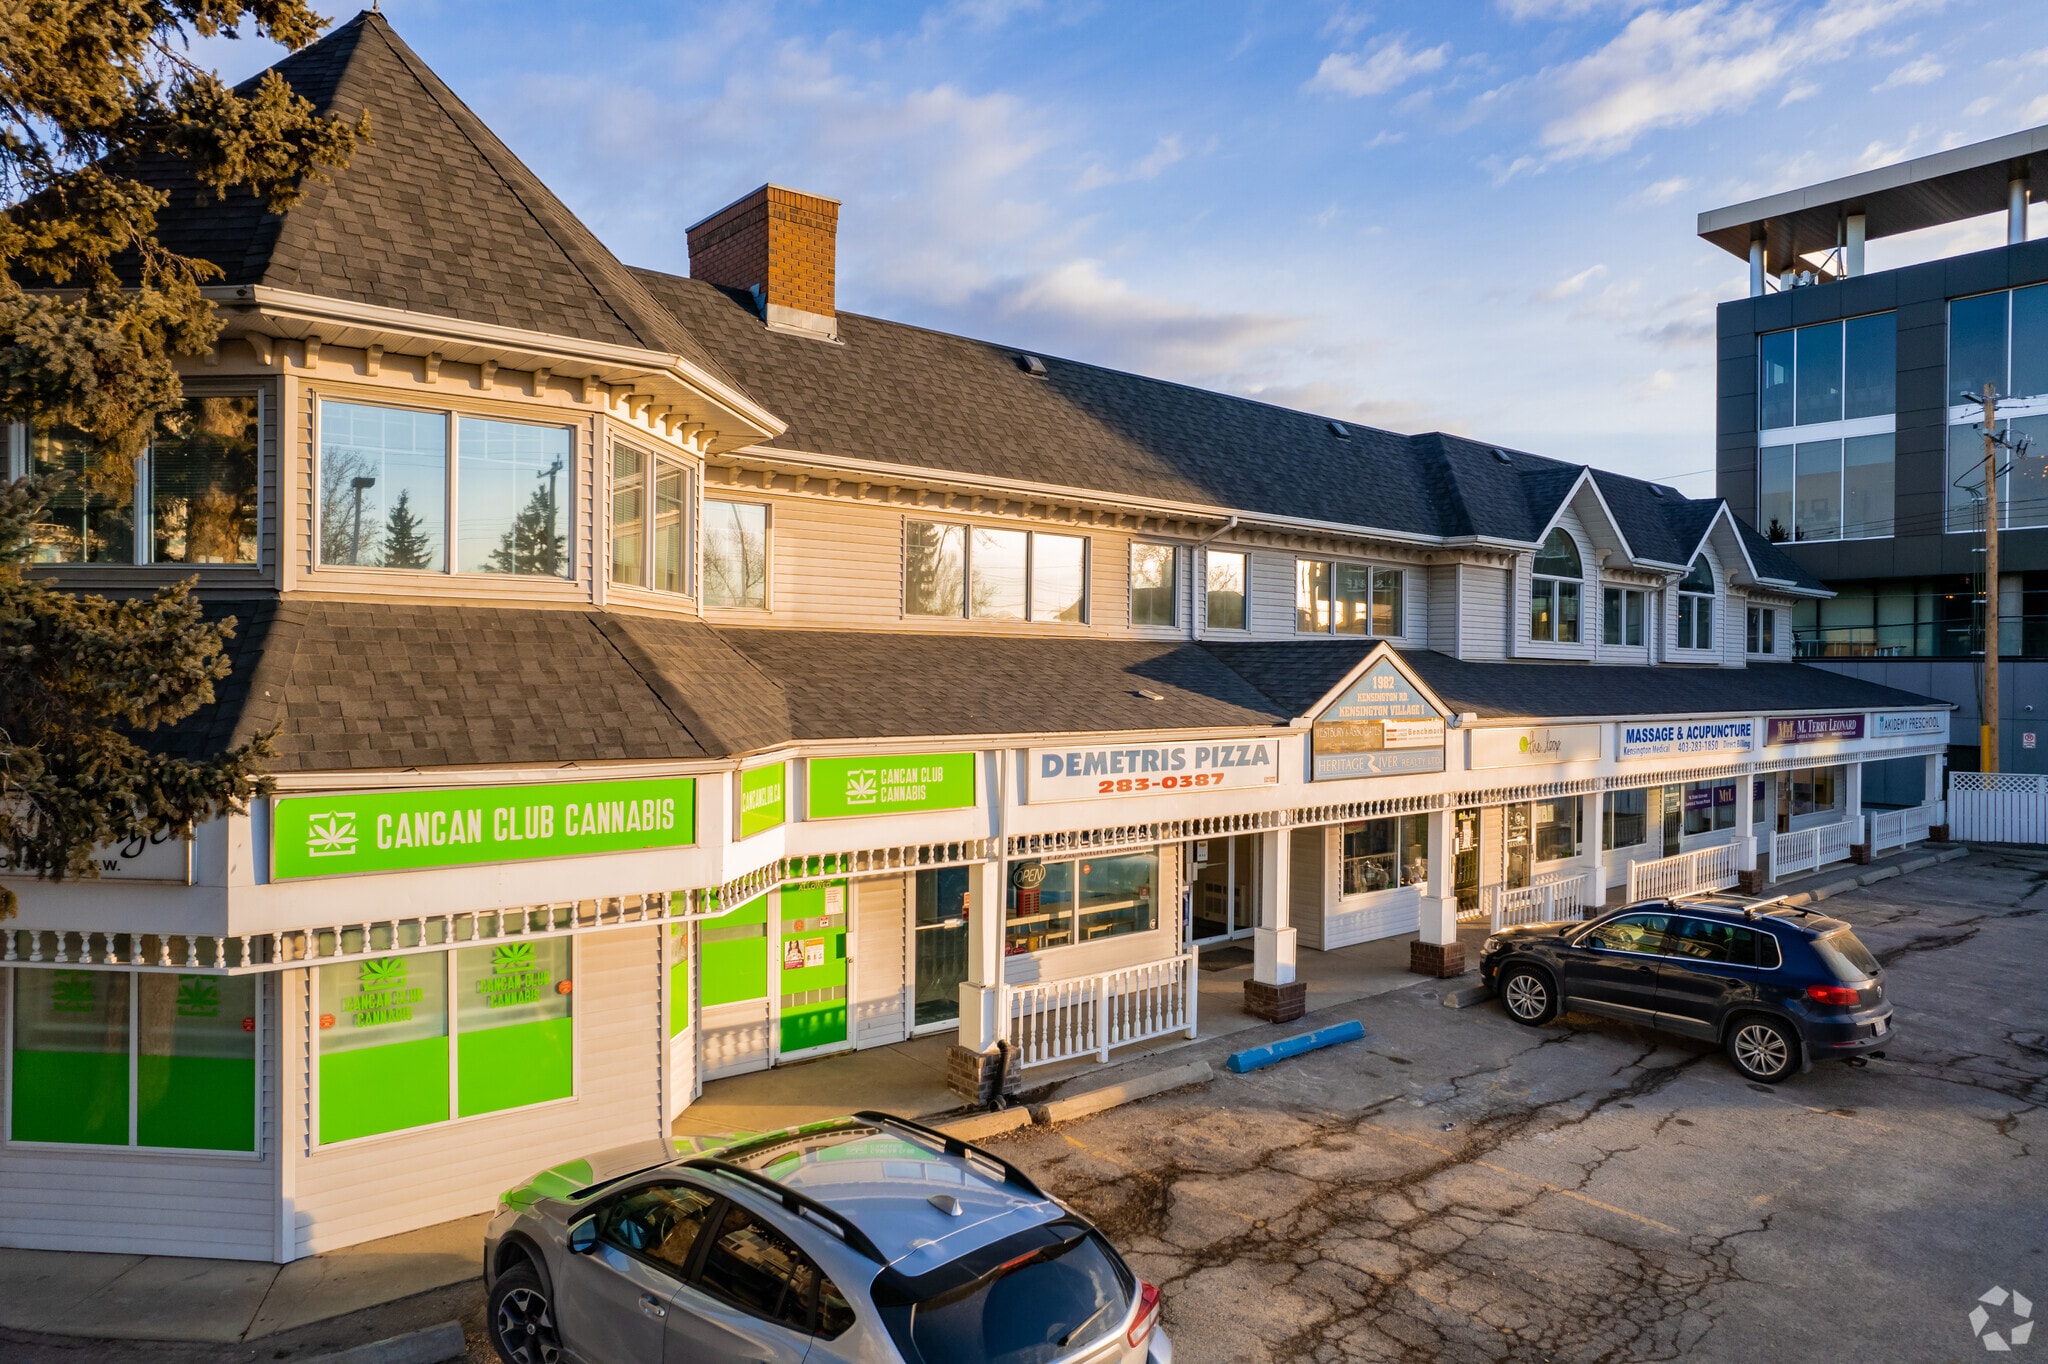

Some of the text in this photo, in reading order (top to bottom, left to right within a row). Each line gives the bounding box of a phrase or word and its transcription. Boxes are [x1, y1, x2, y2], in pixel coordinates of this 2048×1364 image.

[1373, 676, 1394, 689] 1982
[1357, 692, 1398, 702] KENSINGTON
[1339, 705, 1388, 717] KENSINGTON
[1390, 704, 1419, 716] VILLAGE
[1408, 727, 1443, 736] Benchmark
[1884, 716, 1939, 731] AKIDEMY PRESCHOOL
[1626, 723, 1751, 743] MASSAGE & ACUPUNCTURE
[1623, 745, 1651, 756] Kensington
[1652, 743, 1670, 753] Medical
[1677, 740, 1719, 752] 403-283-1850
[1041, 744, 1270, 778] DEMETRIS PIZZA
[1319, 758, 1364, 772] HERITAGE
[1401, 757, 1425, 767] REALTY
[880, 766, 943, 785] CANCAN CLUB
[1098, 773, 1225, 794] 283-0387
[742, 783, 781, 813] CANCANCLUB.CA
[880, 785, 926, 803] CANNABIS
[376, 798, 675, 849] CANCAN CLUB CANNABIS
[1015, 867, 1043, 883] OPEN
[799, 880, 832, 891] ALLOWED
[480, 975, 521, 994] CANCAN
[524, 970, 550, 988] CLUB
[345, 992, 391, 1012] CANCAN
[490, 988, 540, 1008] CANNABIS
